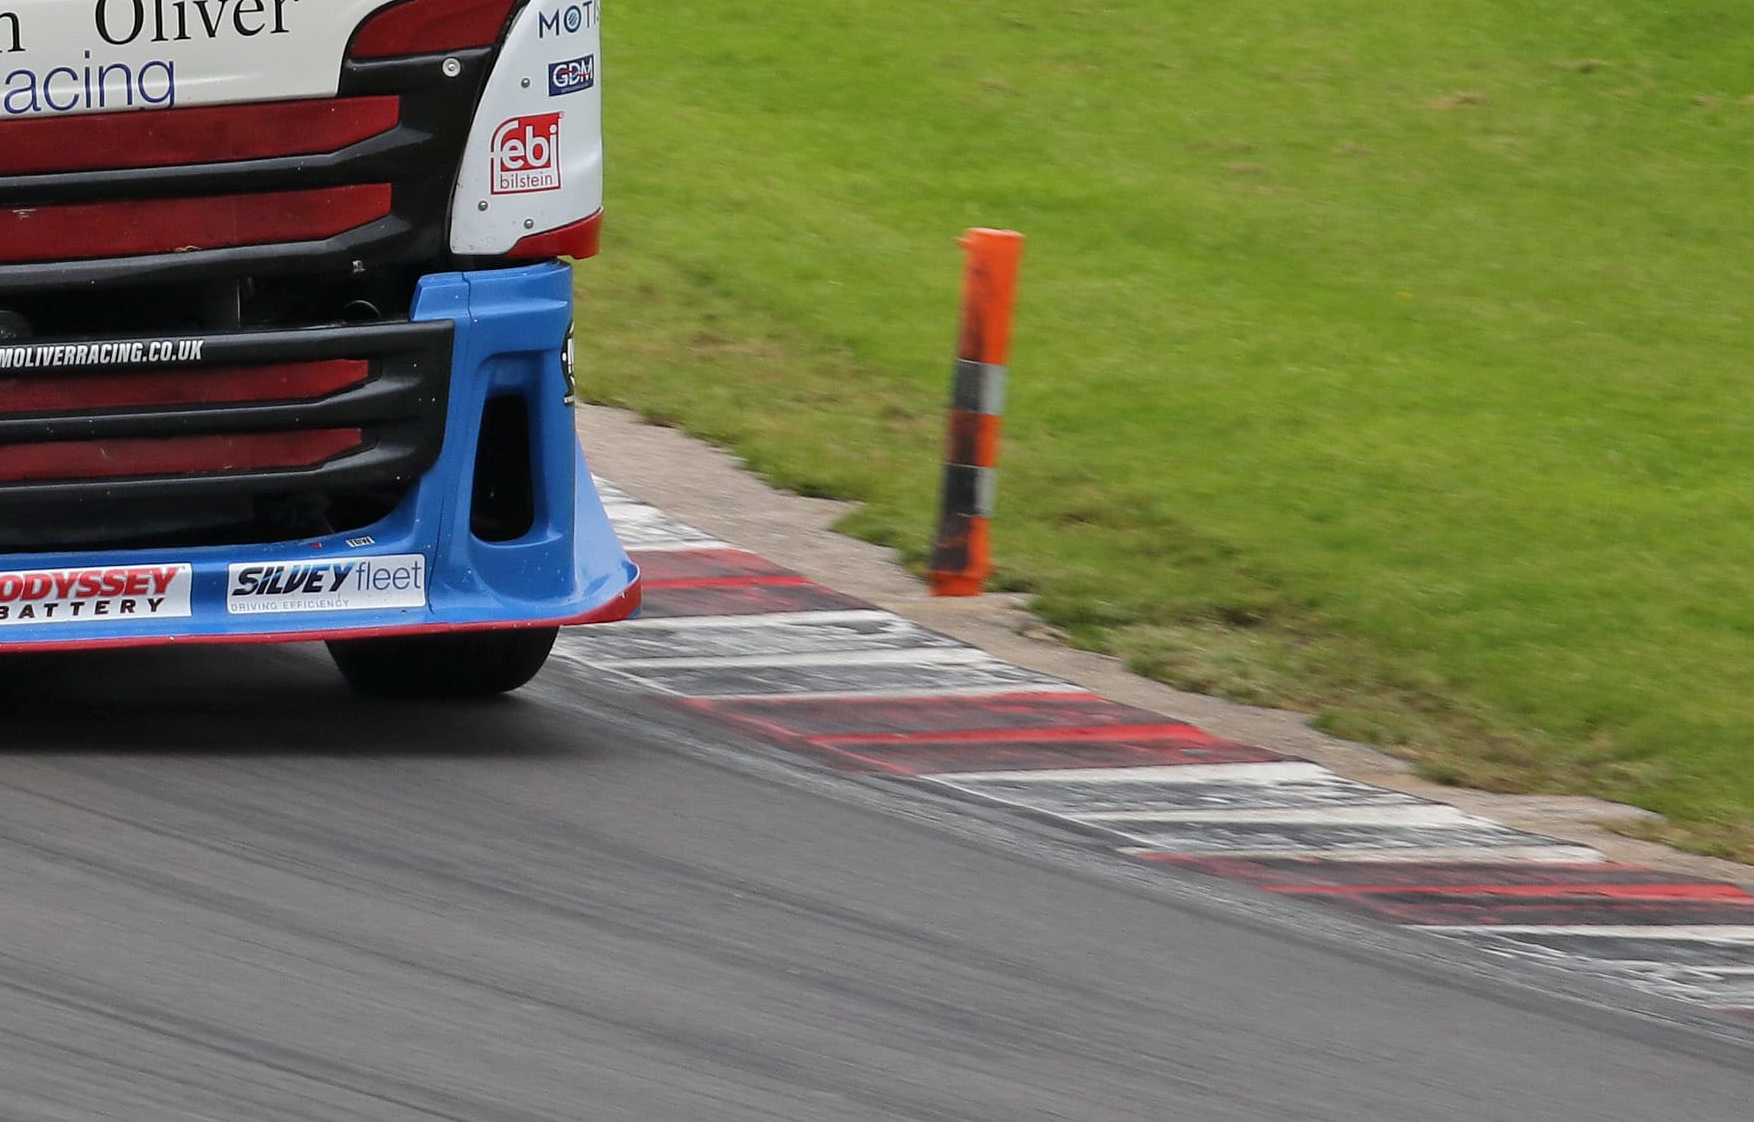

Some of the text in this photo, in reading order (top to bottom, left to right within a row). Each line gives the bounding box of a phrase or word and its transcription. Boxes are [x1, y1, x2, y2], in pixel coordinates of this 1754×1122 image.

[552, 56, 593, 88] GDM
[491, 119, 558, 171] febi
[499, 170, 553, 191] bilstein
[356, 561, 422, 591] fleet
[231, 599, 350, 612] DRIVING EFFICIENCY
